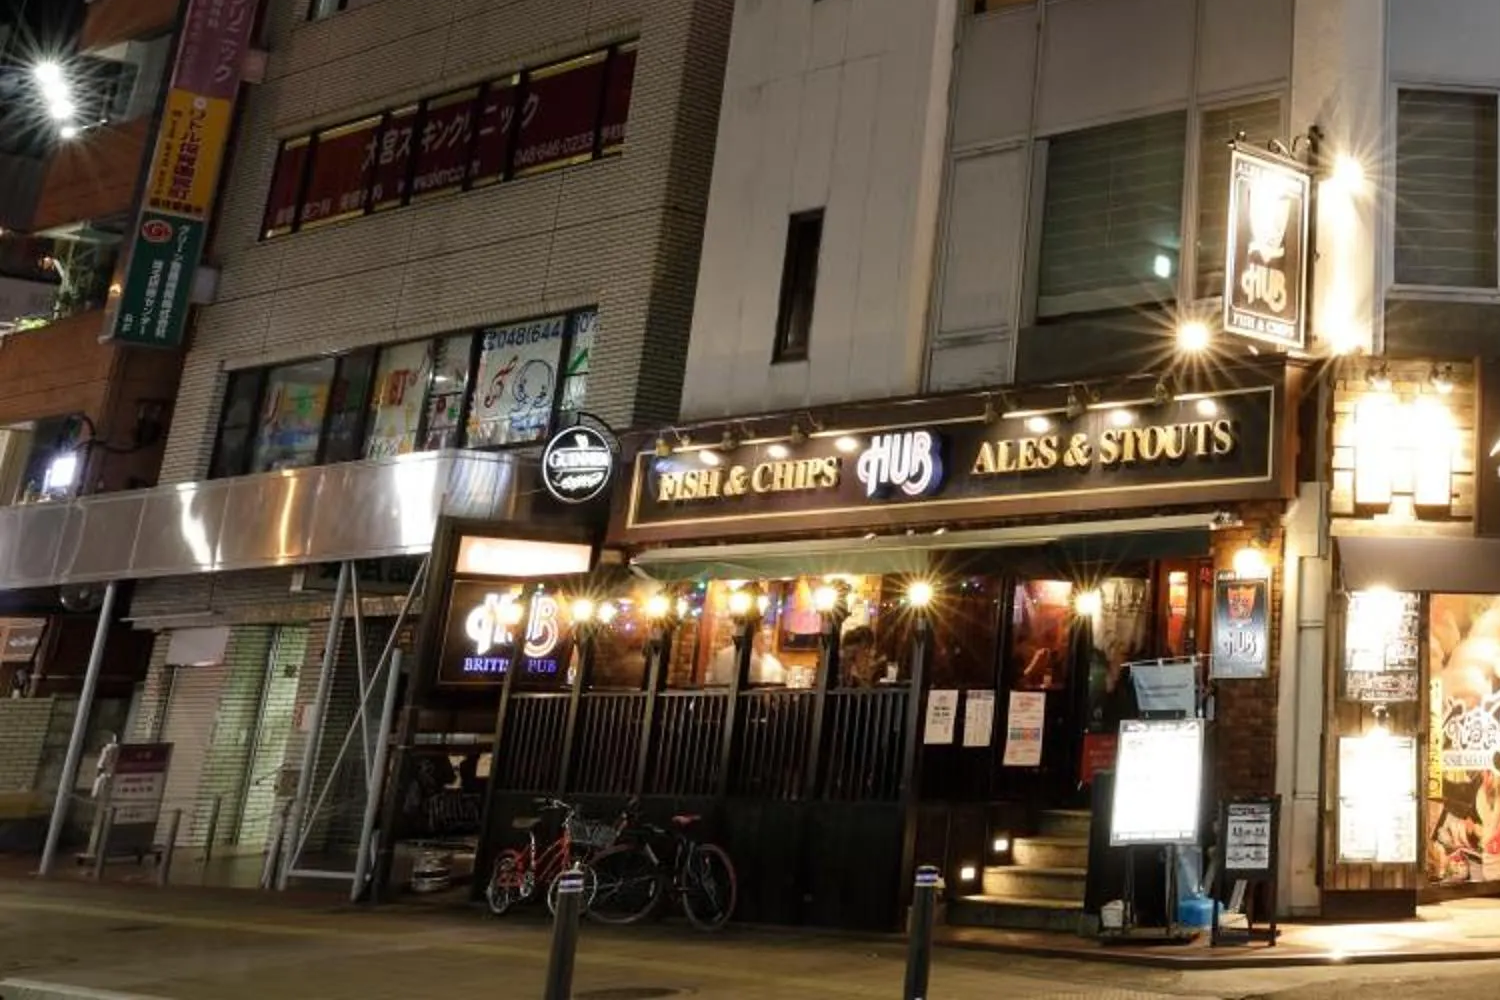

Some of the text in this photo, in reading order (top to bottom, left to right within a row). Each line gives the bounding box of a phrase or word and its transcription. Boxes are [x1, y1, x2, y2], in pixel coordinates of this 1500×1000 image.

[1241, 262, 1287, 313] HUB
[857, 431, 932, 497] HUB
[970, 419, 1233, 475] ALES & STOUTS
[657, 456, 840, 501] FISH & CHIPS
[527, 658, 557, 673] PUB
